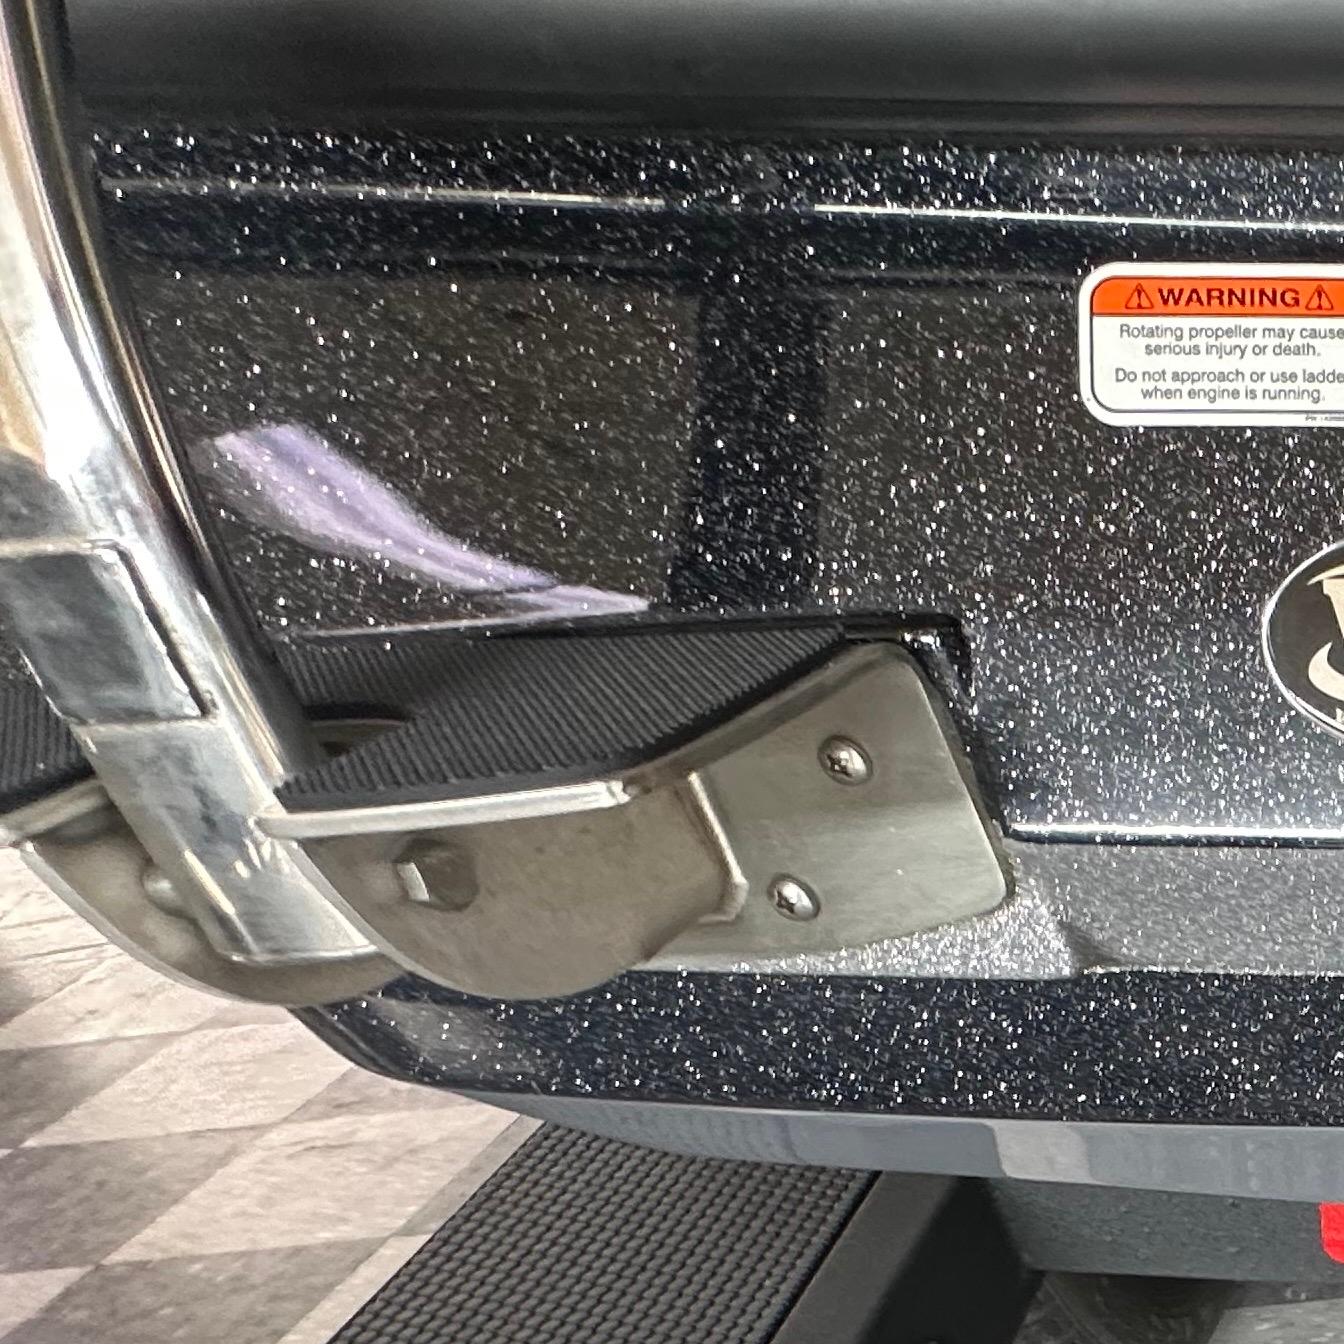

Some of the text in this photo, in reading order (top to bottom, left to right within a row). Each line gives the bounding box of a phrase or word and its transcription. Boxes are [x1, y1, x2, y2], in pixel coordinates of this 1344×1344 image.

[1158, 287, 1300, 307] WARNING
[1120, 324, 1184, 340] Rotating
[1188, 325, 1258, 342] propeller
[1262, 327, 1294, 342] may
[1144, 342, 1321, 359] serious injury or death.
[1115, 368, 1138, 383] Do
[1142, 369, 1166, 383] not
[1171, 369, 1245, 386] approach
[1250, 371, 1266, 383] or
[1271, 371, 1298, 384] use
[1141, 386, 1325, 404] when engine is running.
